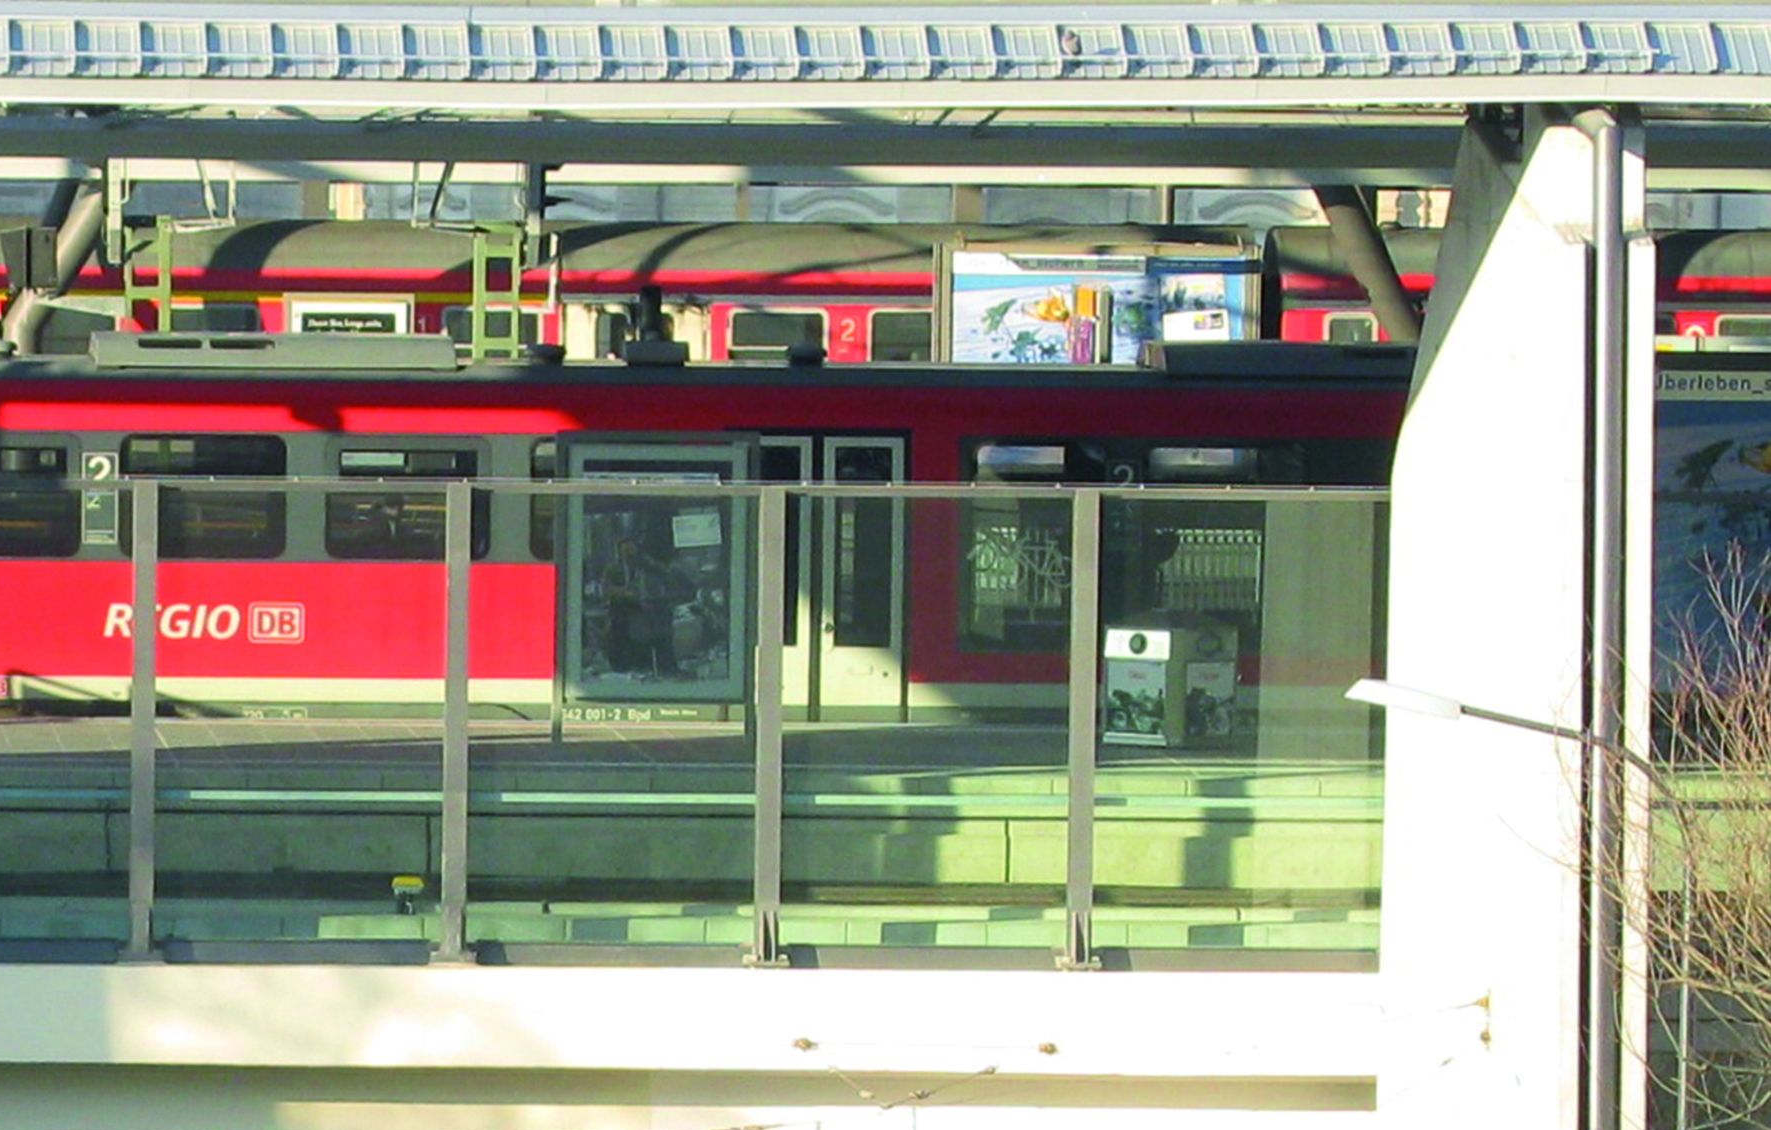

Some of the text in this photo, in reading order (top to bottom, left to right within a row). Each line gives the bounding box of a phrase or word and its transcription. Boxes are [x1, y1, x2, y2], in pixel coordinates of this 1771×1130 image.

[840, 318, 856, 342] 2
[103, 602, 298, 640] RGIO DB
